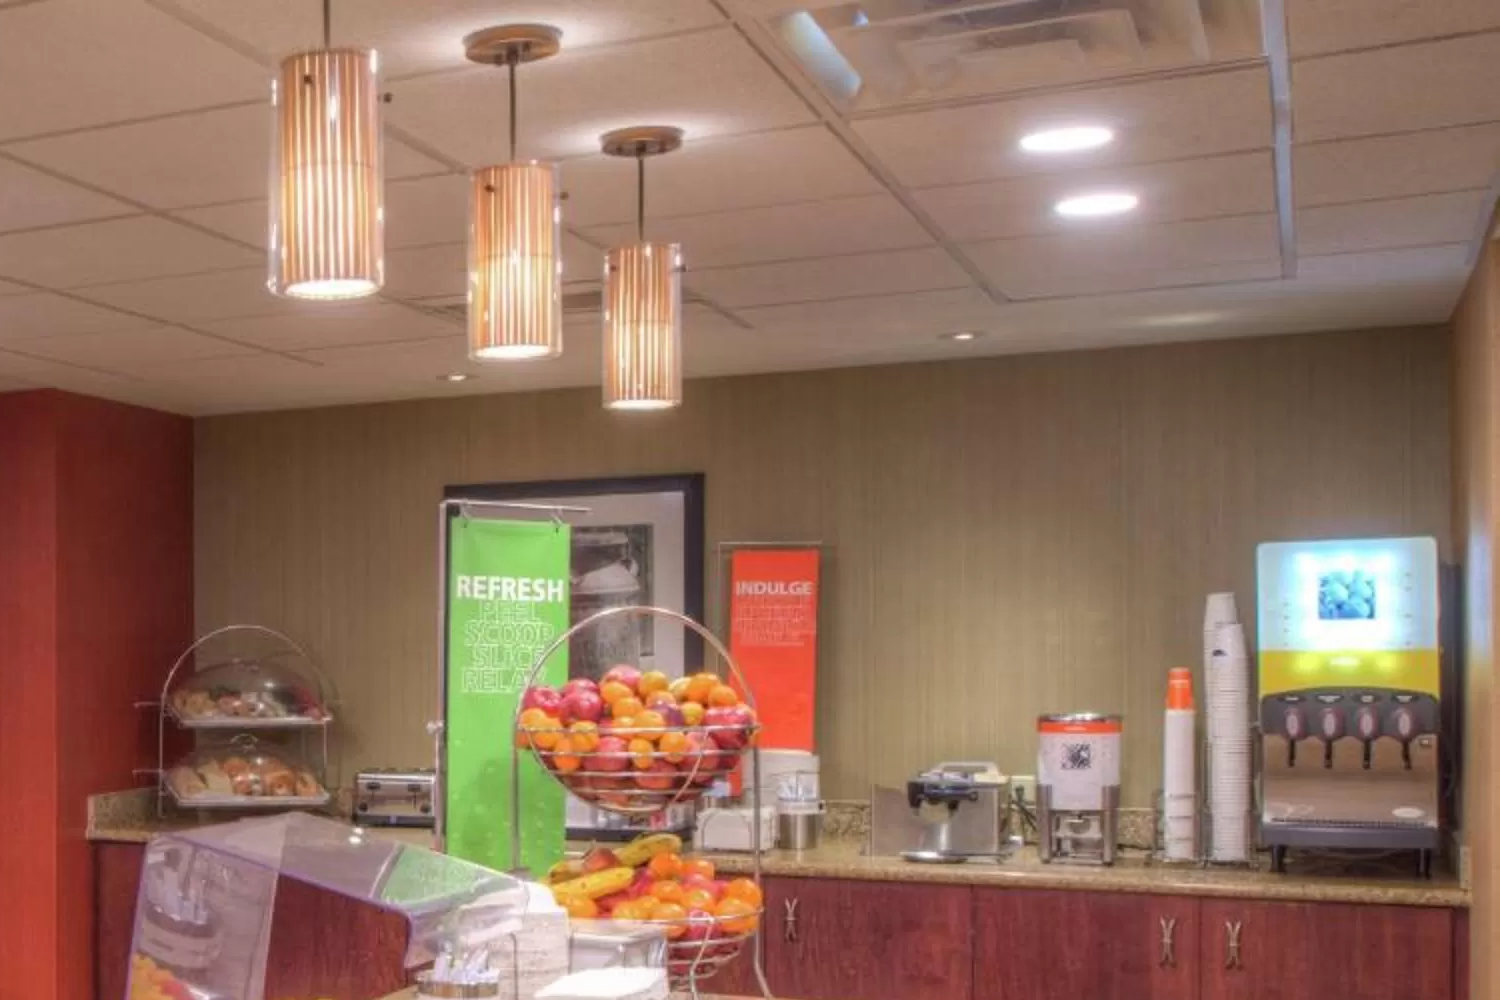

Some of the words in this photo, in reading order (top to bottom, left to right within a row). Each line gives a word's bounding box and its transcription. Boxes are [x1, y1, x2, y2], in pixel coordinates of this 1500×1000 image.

[456, 575, 564, 602] REFRESH
[736, 580, 812, 596] INDULGE
[479, 600, 541, 623] PEEL
[463, 619, 555, 647] SCOOP
[461, 667, 546, 693] RELA
